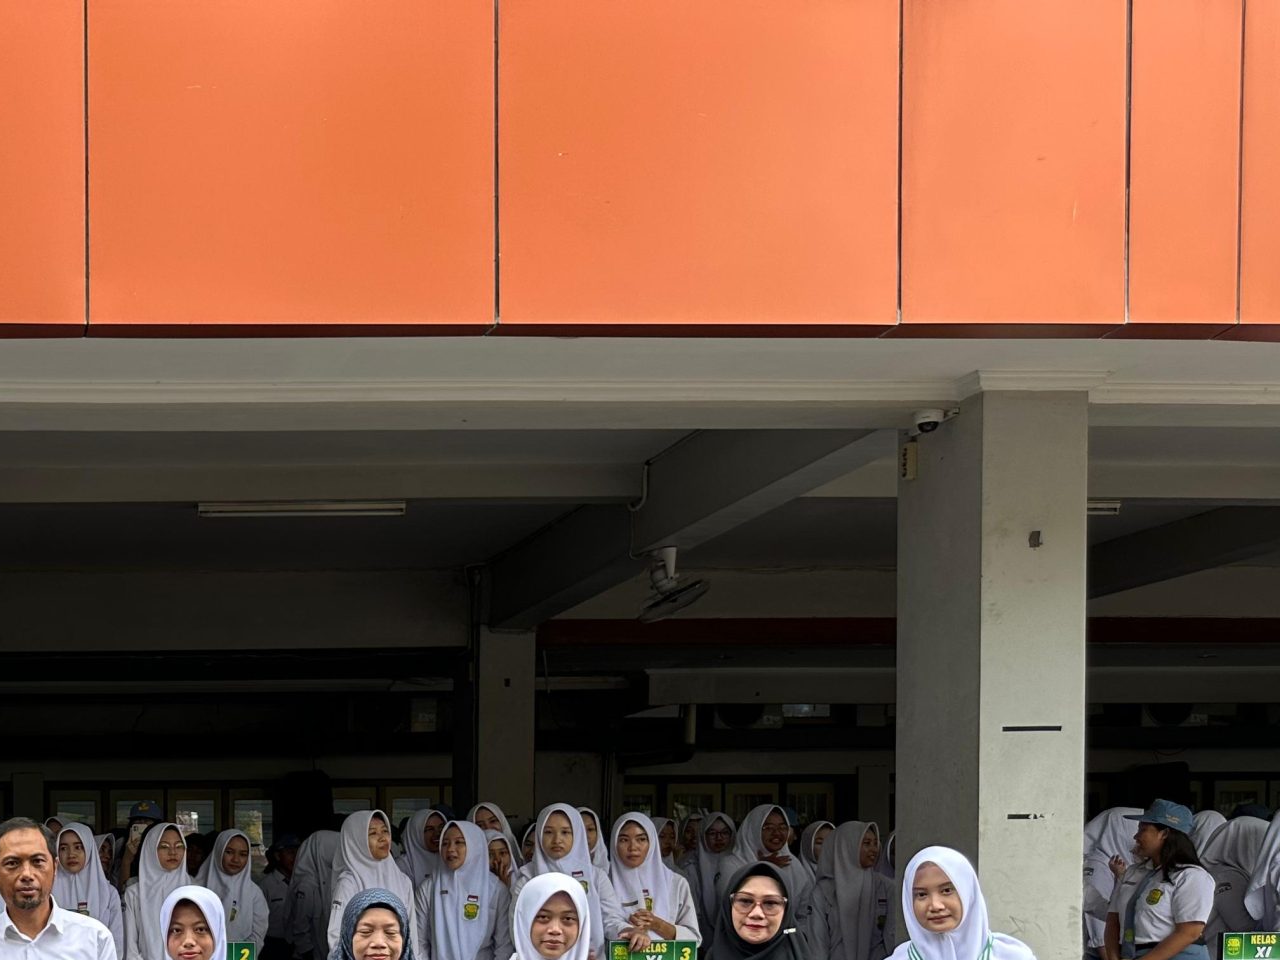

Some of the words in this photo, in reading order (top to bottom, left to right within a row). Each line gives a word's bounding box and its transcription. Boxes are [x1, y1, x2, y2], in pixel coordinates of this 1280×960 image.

[1251, 935, 1276, 944] KELAS
[640, 943, 667, 953] ELAS
[1255, 947, 1272, 958] XI
